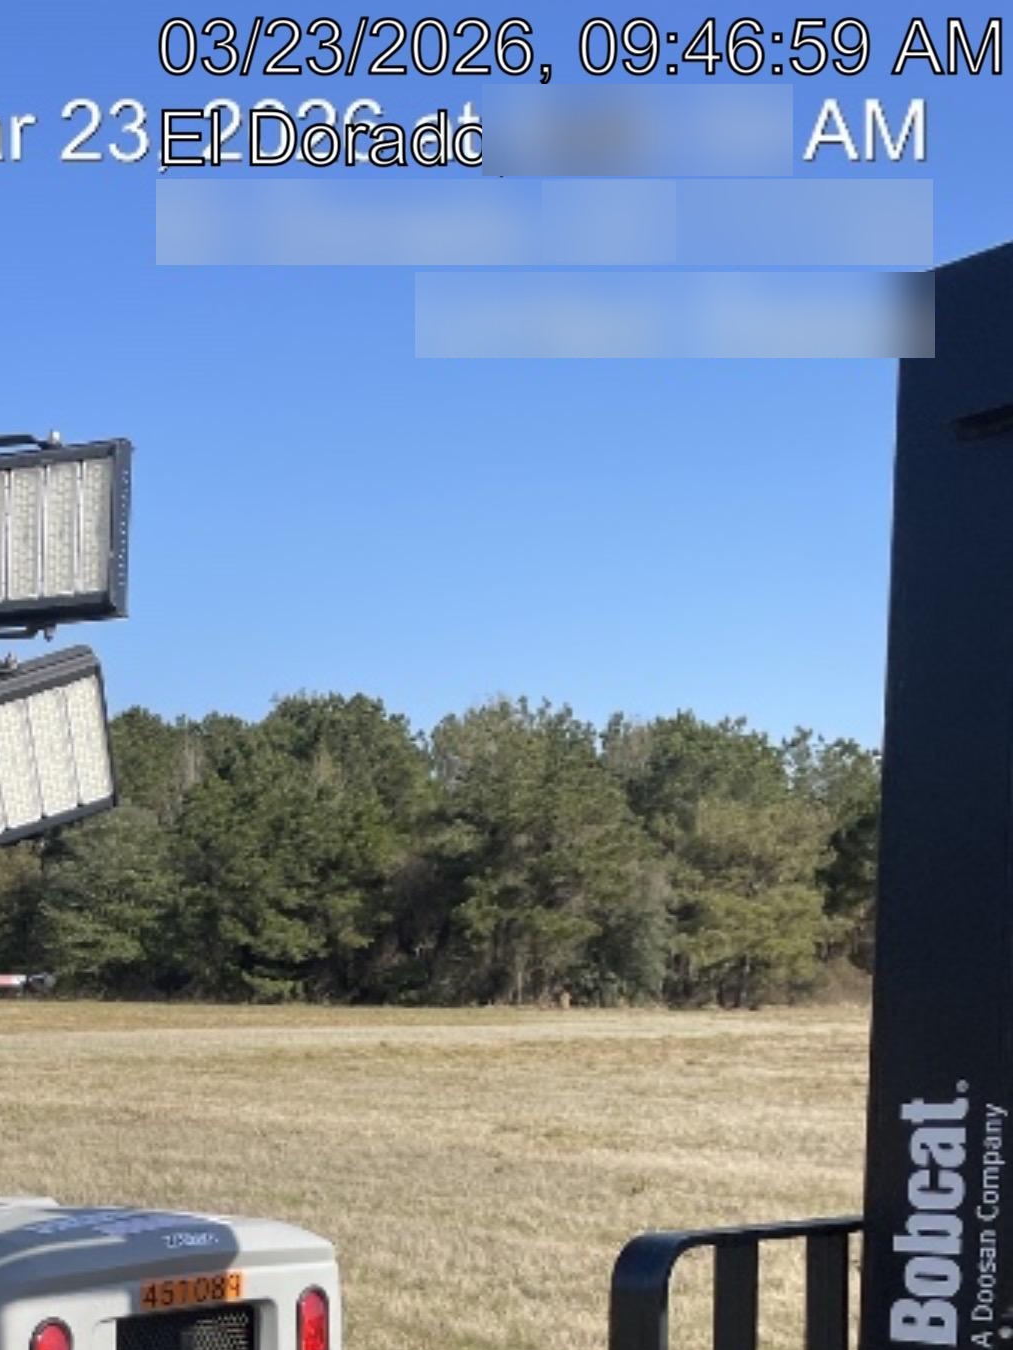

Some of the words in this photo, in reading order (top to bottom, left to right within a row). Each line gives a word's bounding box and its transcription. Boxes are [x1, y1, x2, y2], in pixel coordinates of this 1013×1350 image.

[975, 1103, 1009, 1222] Company
[890, 1097, 969, 1348] Bobcat
[970, 1229, 997, 1322] Doosan
[971, 1330, 993, 1349] A
